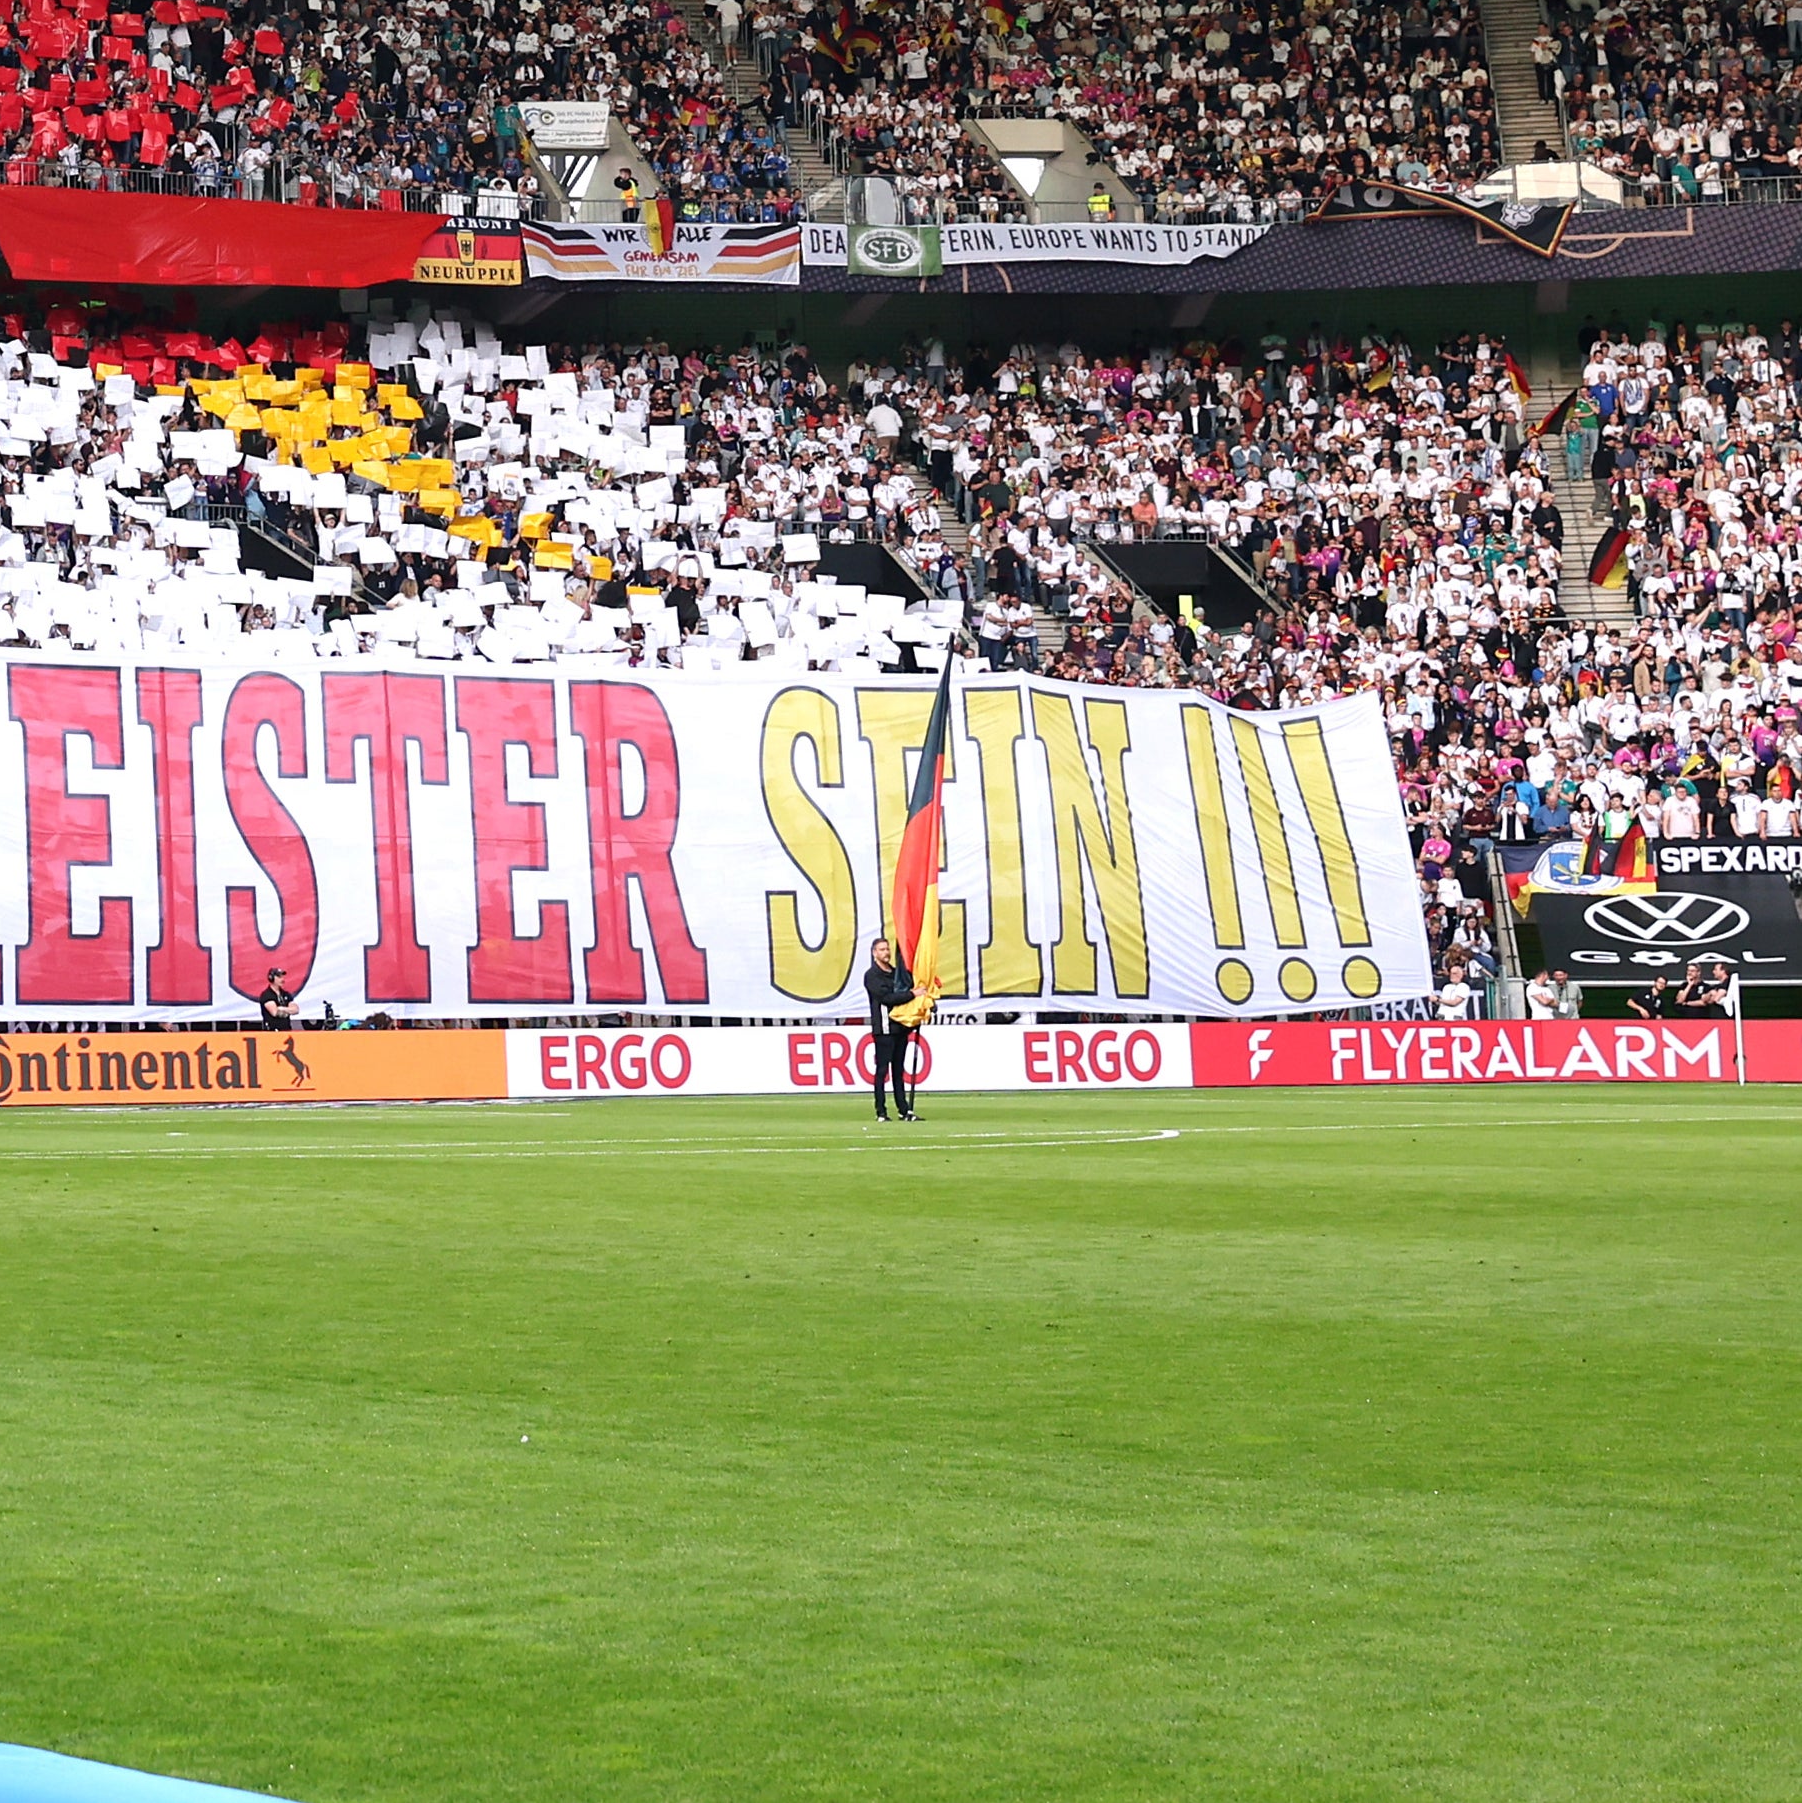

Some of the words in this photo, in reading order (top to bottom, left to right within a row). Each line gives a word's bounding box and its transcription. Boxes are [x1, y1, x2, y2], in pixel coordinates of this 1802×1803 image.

[602, 227, 640, 244] WIR
[676, 226, 714, 242] ALLE
[868, 239, 910, 261] SFB
[1011, 228, 1087, 250] EUROPE
[1090, 229, 1157, 253] WANTS
[1162, 229, 1188, 253] TO
[759, 684, 1151, 1003] SEIN
[541, 1032, 692, 1091] ERGO
[1024, 1029, 1162, 1083] ERGO
[1329, 1026, 1723, 1082] FLYERALARM
